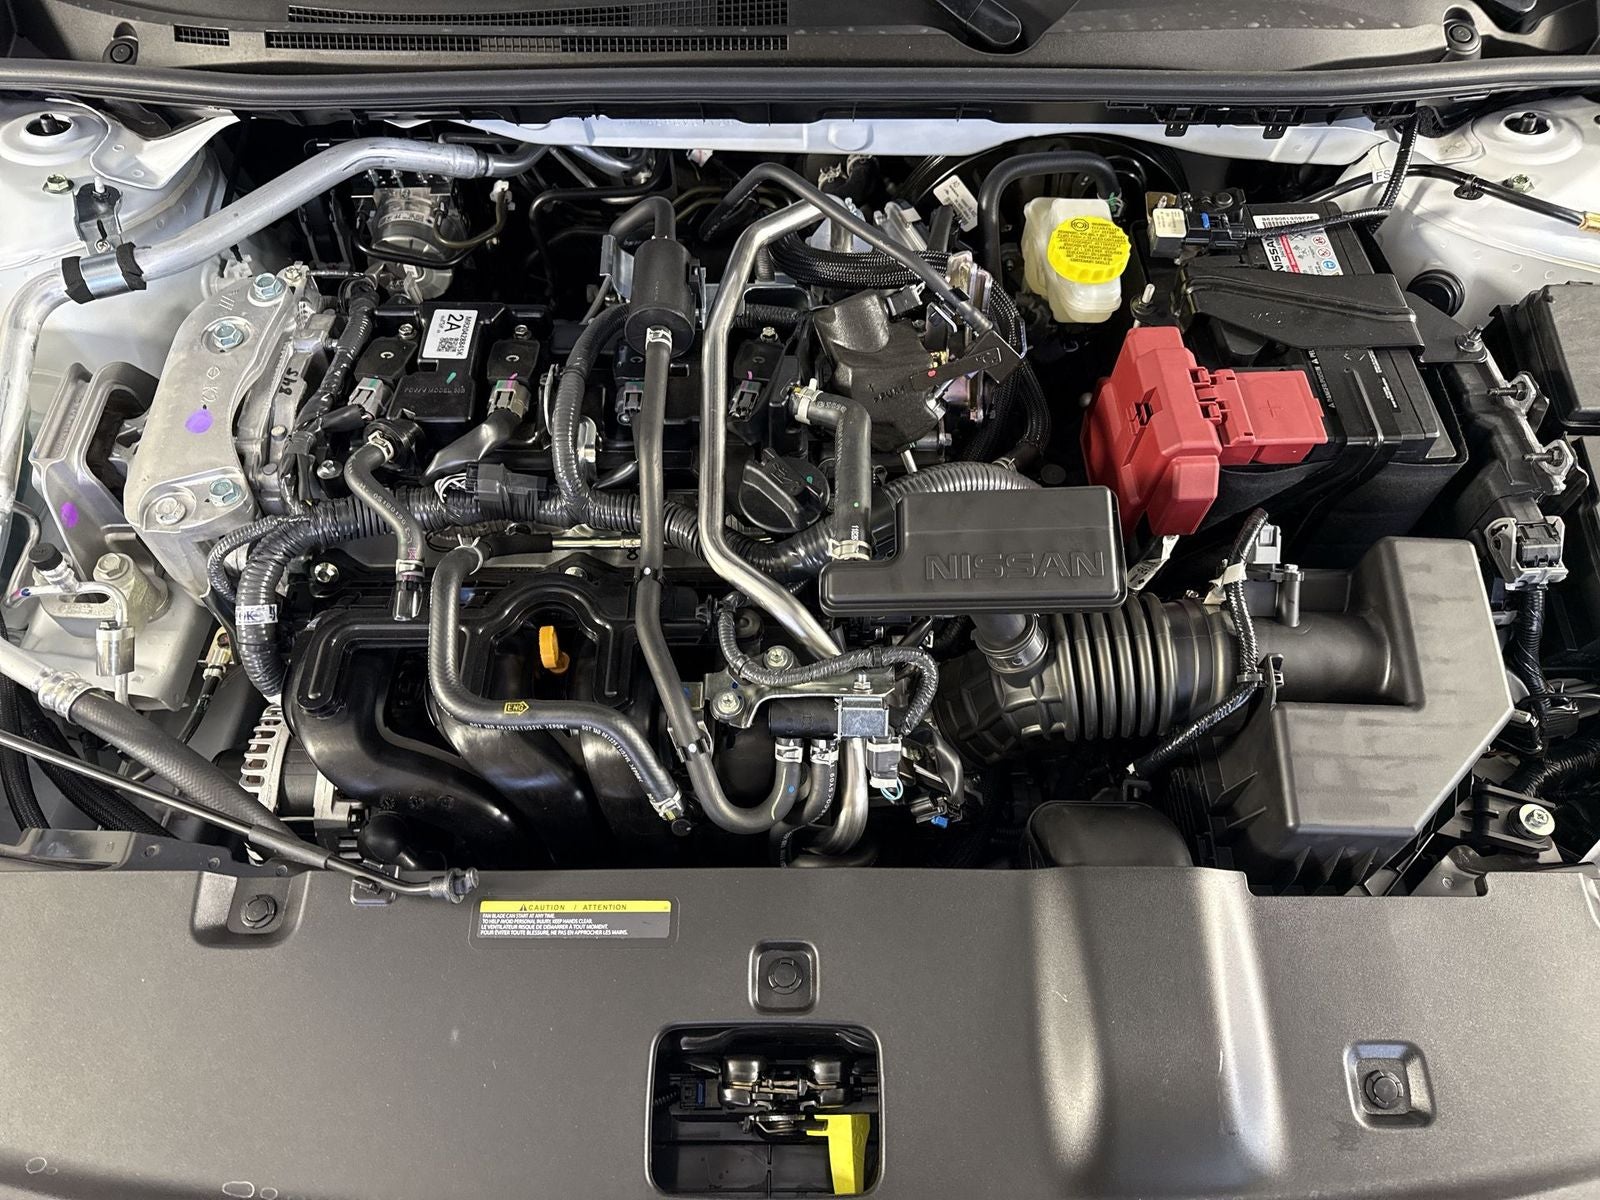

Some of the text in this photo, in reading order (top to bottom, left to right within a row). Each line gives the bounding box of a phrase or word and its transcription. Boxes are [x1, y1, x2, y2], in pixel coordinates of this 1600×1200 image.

[444, 313, 464, 332] 2A
[925, 551, 1105, 581] NISSAN
[528, 904, 566, 912] CAUTION
